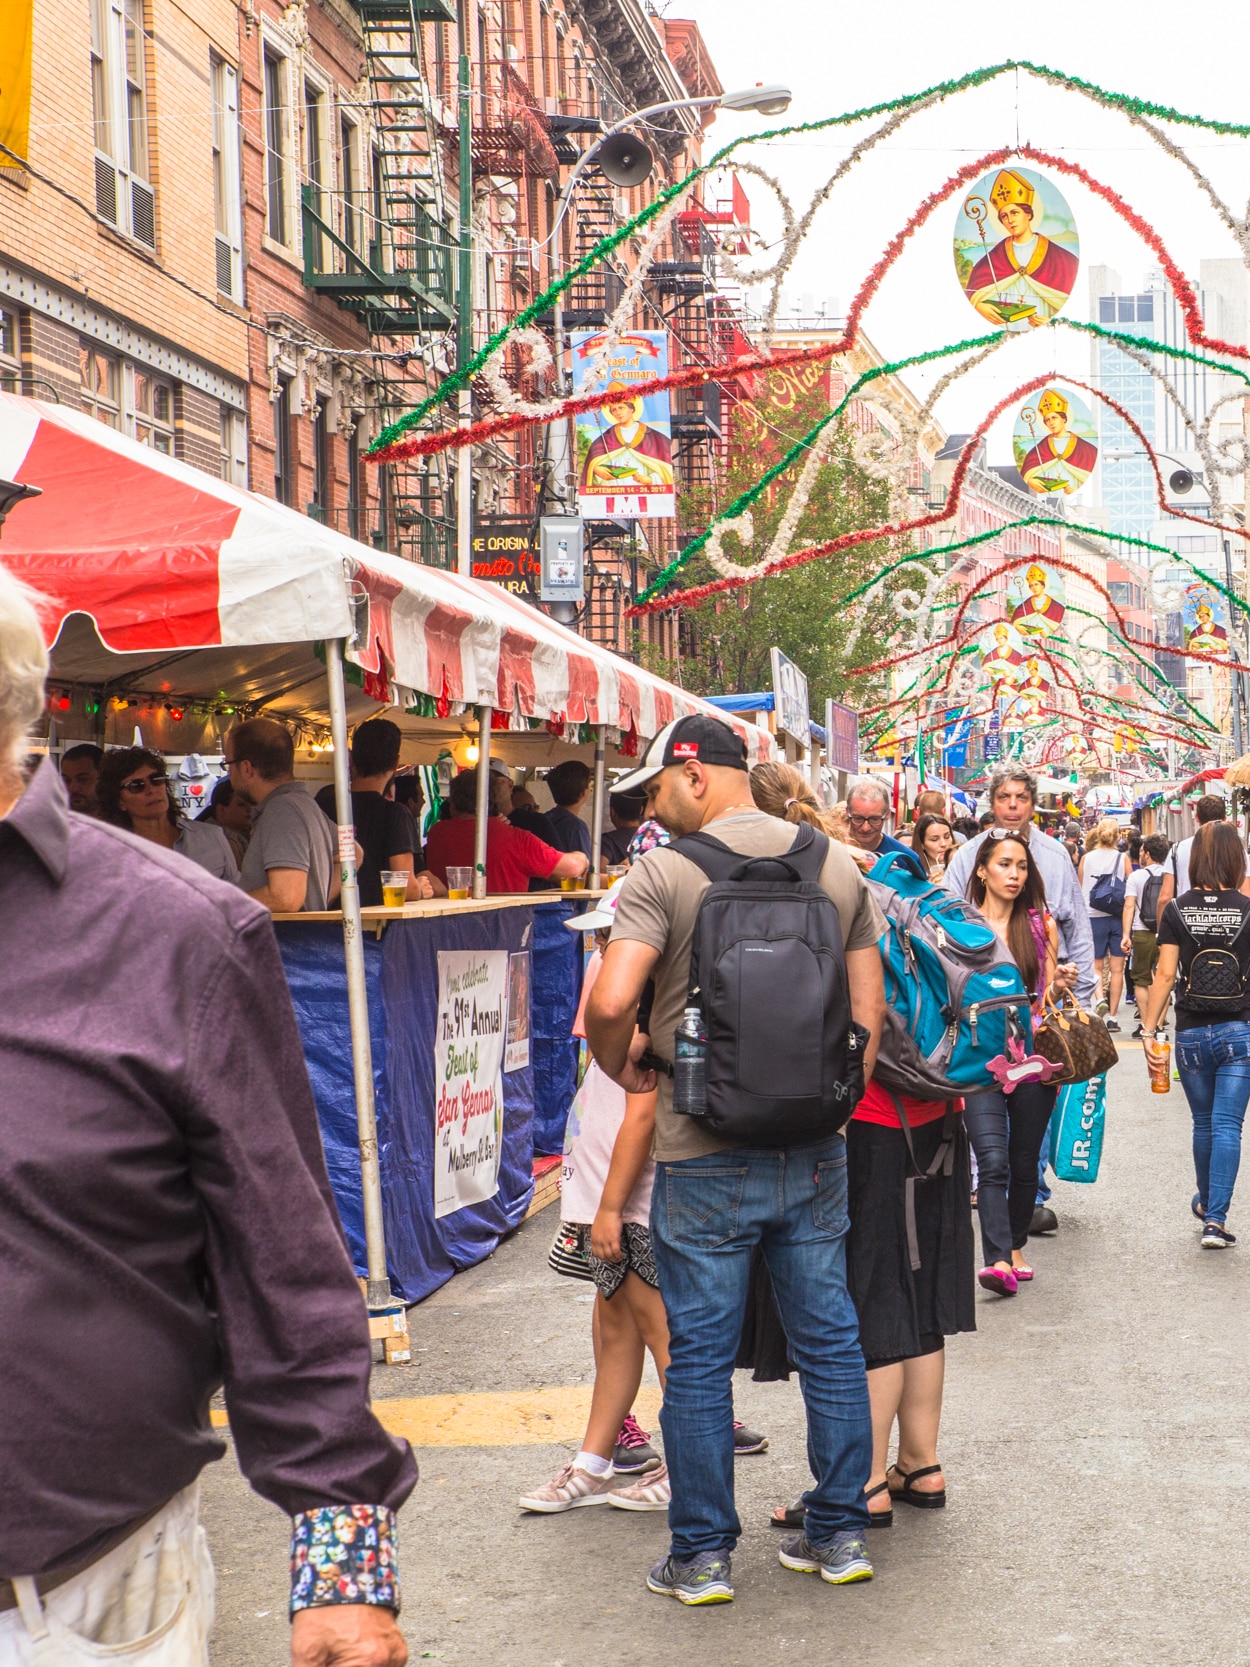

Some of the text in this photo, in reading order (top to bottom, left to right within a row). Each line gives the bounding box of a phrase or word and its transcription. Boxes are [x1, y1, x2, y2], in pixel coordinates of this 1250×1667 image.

[606, 355, 641, 368] east of
[610, 369, 657, 380] Gennaro
[472, 536, 541, 551] HE ORIGINL
[181, 796, 205, 809] NY
[182, 785, 189, 796] I
[1183, 914, 1242, 924] lacklabelcorps
[461, 955, 489, 991] celebrate
[442, 993, 502, 1041] The 91st Annual
[445, 1040, 479, 1085] Feast of
[436, 1082, 460, 1137] San
[1071, 1077, 1102, 1171] JR.com
[448, 1143, 478, 1177] Mulberry
